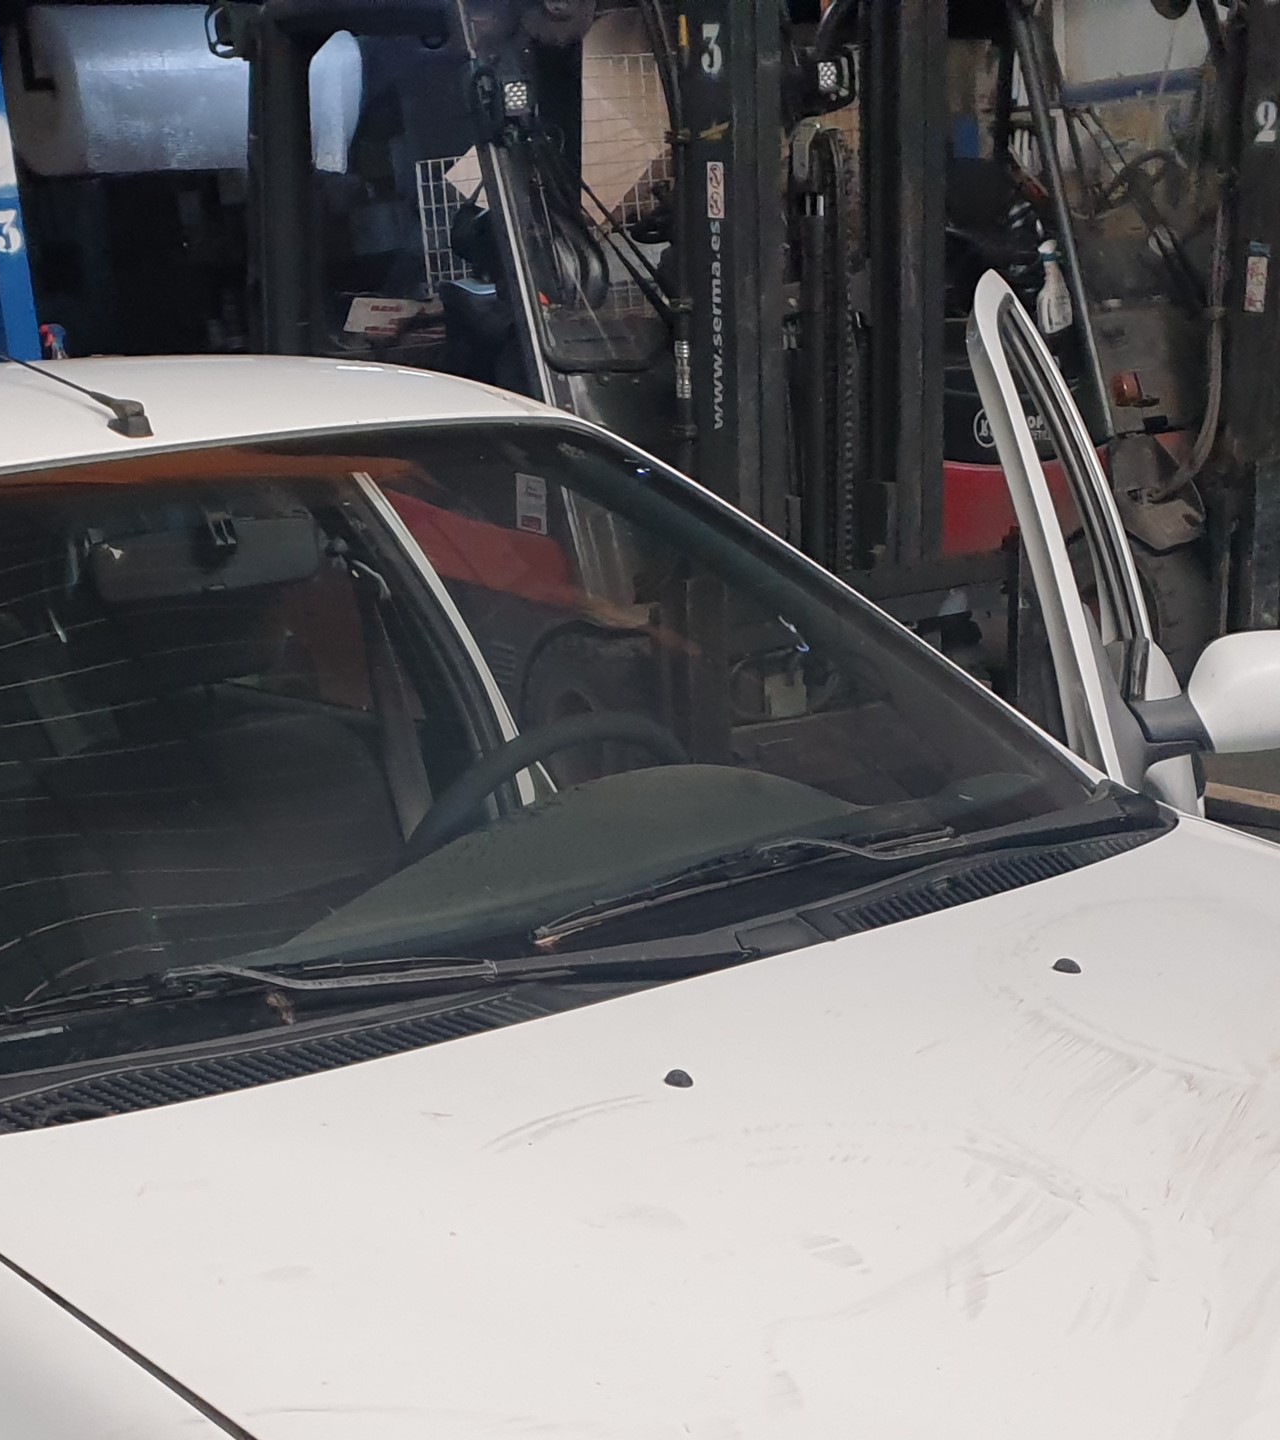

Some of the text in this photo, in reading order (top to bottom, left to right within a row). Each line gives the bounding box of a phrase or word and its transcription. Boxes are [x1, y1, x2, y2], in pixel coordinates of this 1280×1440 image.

[701, 23, 722, 75] 3
[1254, 101, 1278, 143] 2
[710, 221, 723, 430] www.serma.es
